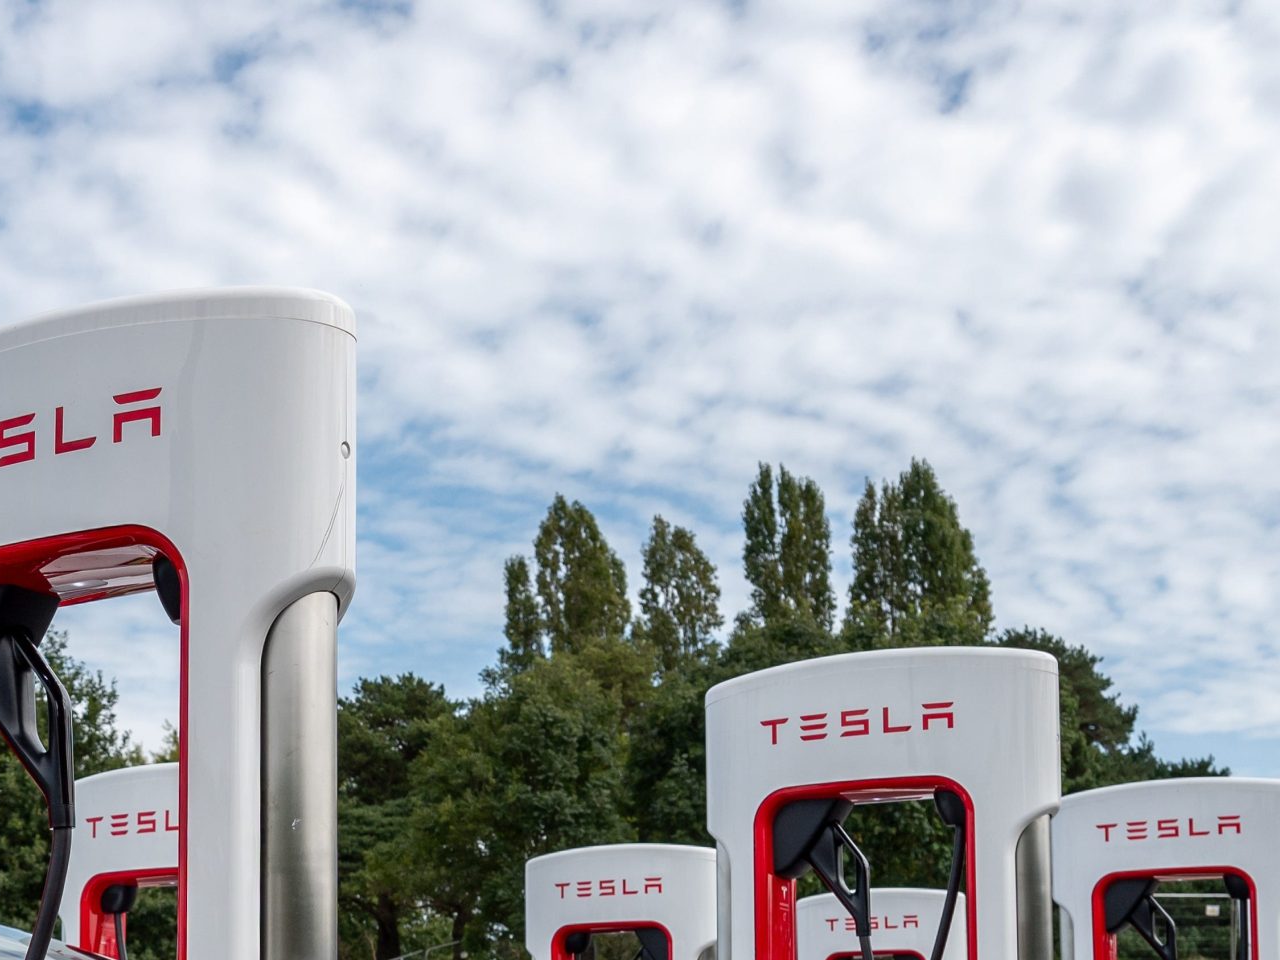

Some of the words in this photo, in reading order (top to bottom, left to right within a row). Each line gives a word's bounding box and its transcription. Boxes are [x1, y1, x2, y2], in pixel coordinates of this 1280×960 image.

[760, 701, 955, 745] TESLA
[85, 810, 179, 838] TESL
[1096, 815, 1241, 842] TESLA
[555, 877, 663, 899] TESLA
